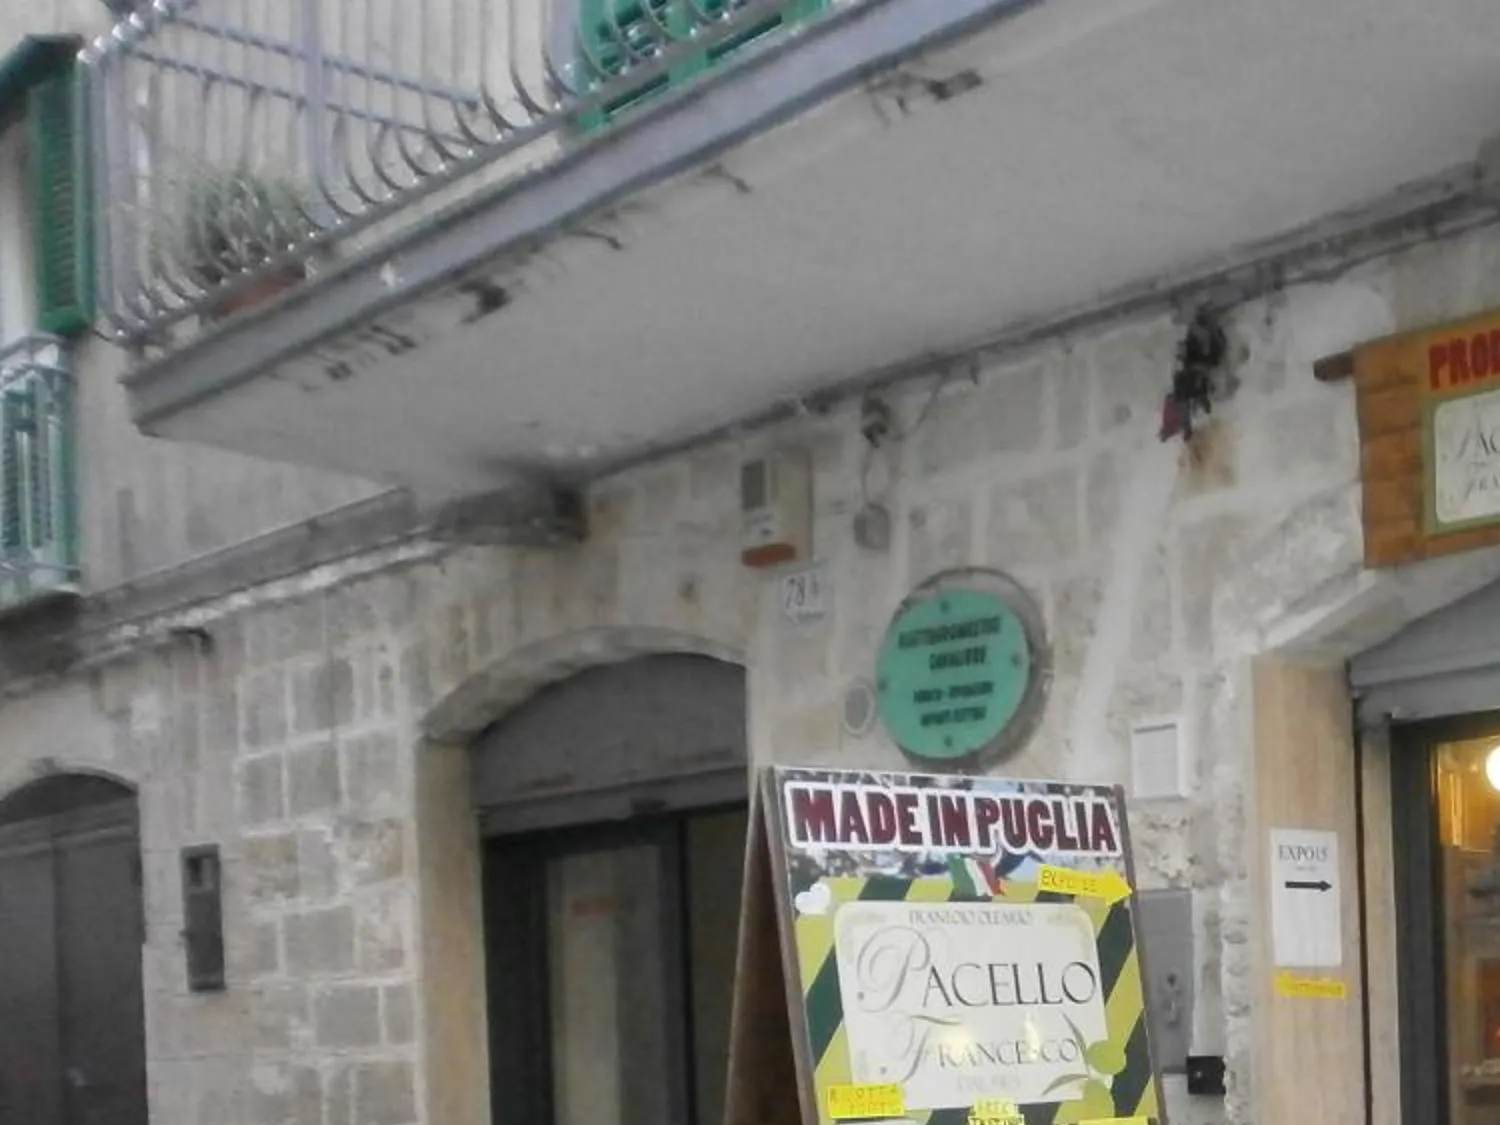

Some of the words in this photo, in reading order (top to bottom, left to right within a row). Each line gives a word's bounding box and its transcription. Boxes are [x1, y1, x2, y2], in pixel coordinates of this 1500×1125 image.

[792, 787, 922, 844] MADE
[928, 793, 973, 847] IN
[976, 796, 1118, 852] PUGLIA
[856, 925, 1097, 1013] PACELLO
